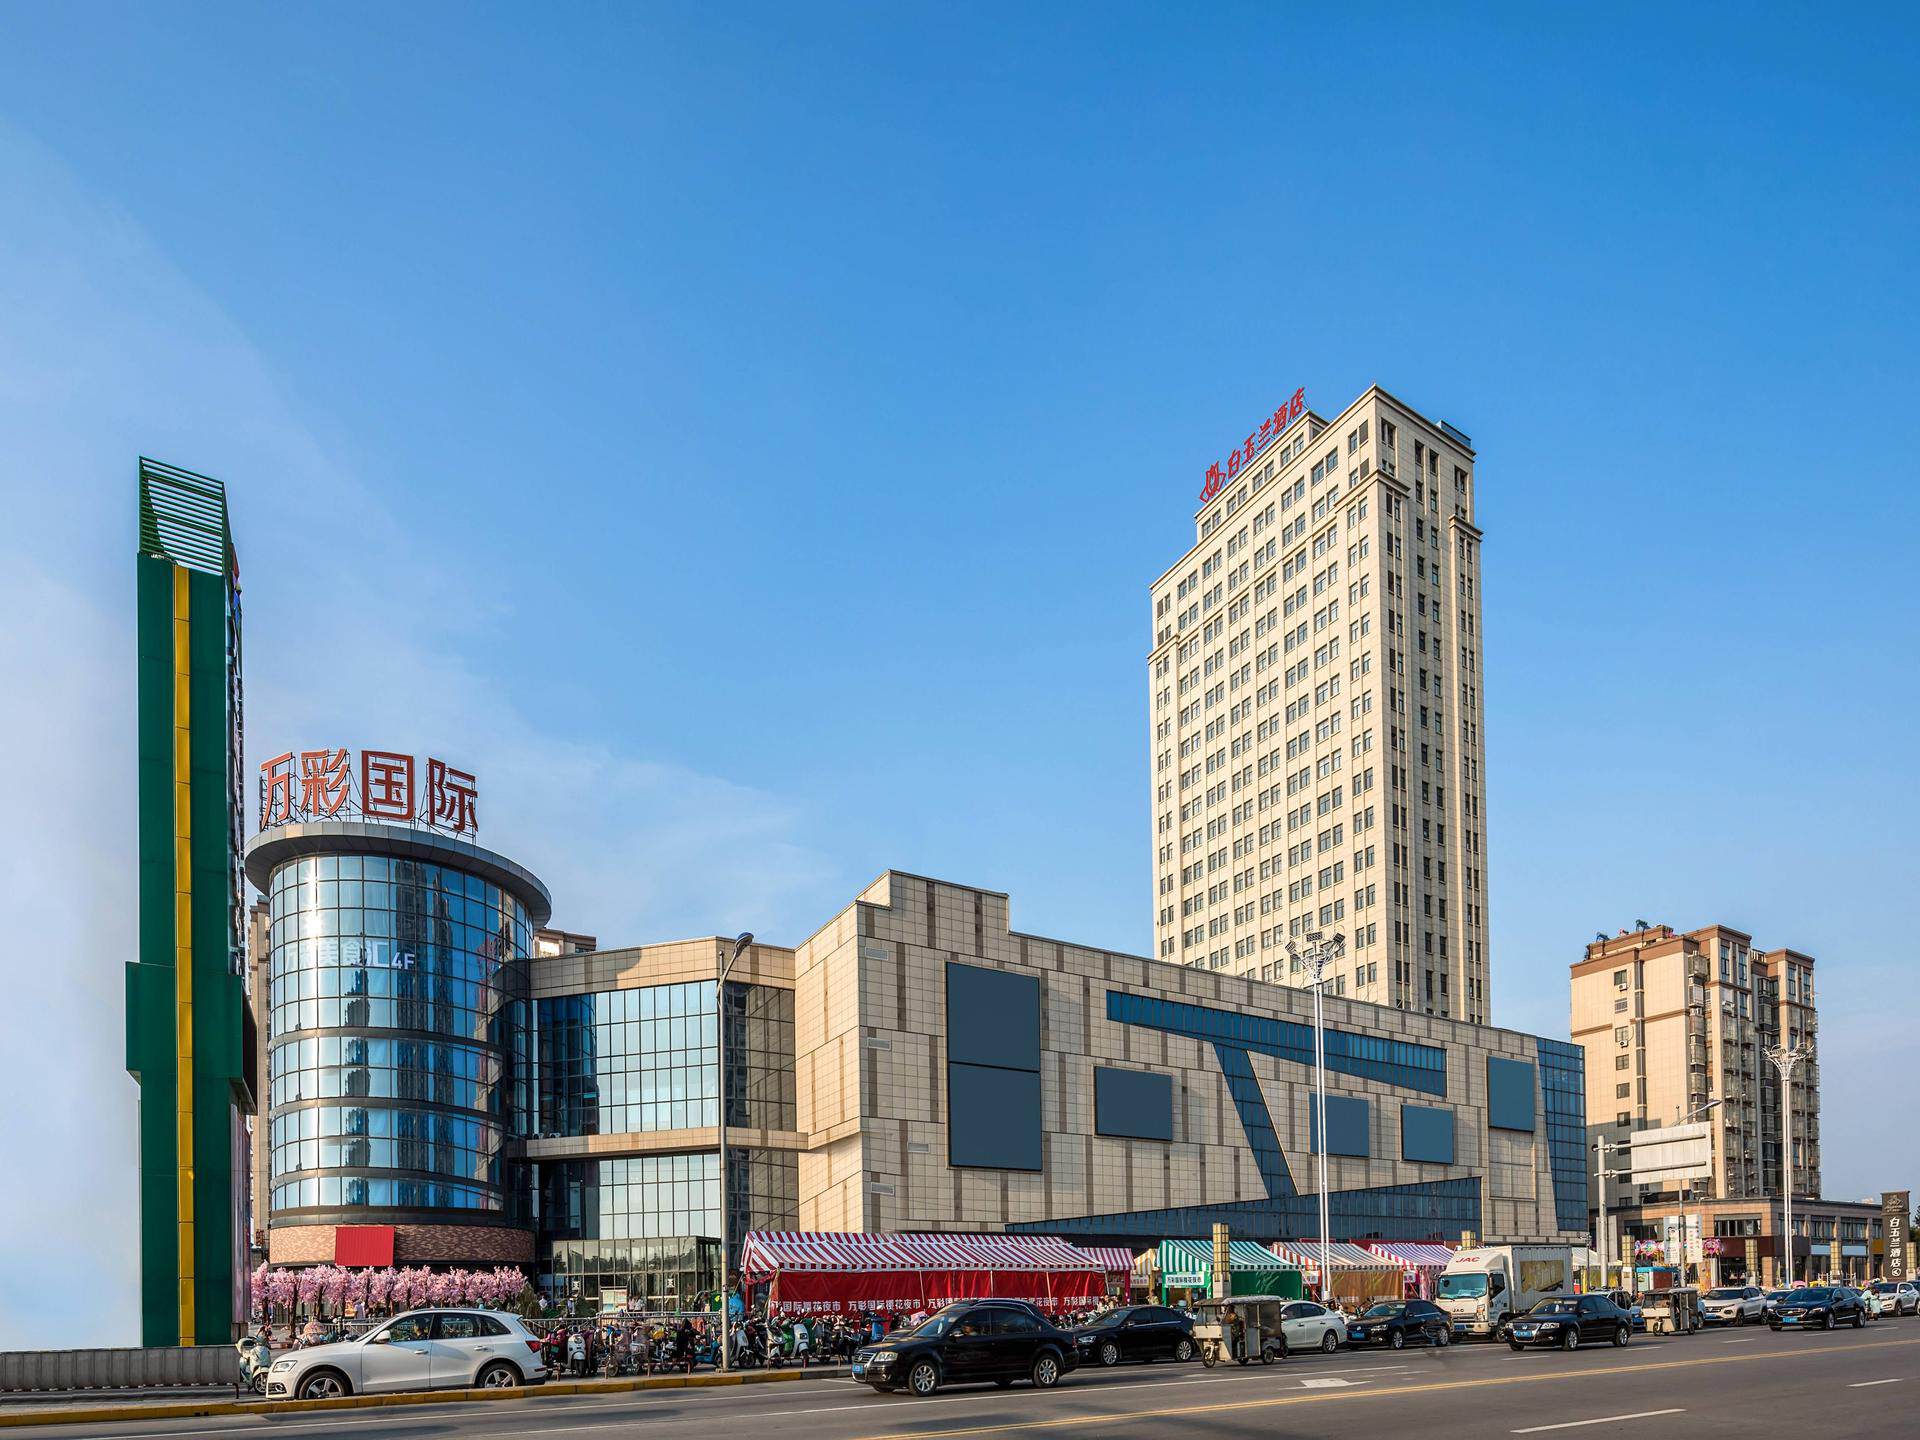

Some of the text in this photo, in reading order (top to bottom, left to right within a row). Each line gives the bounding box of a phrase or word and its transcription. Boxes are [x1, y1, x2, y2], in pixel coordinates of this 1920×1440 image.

[1227, 386, 1305, 479] 白玉兰酒店
[260, 748, 479, 832] 万彩国际
[391, 951, 416, 970] 4F
